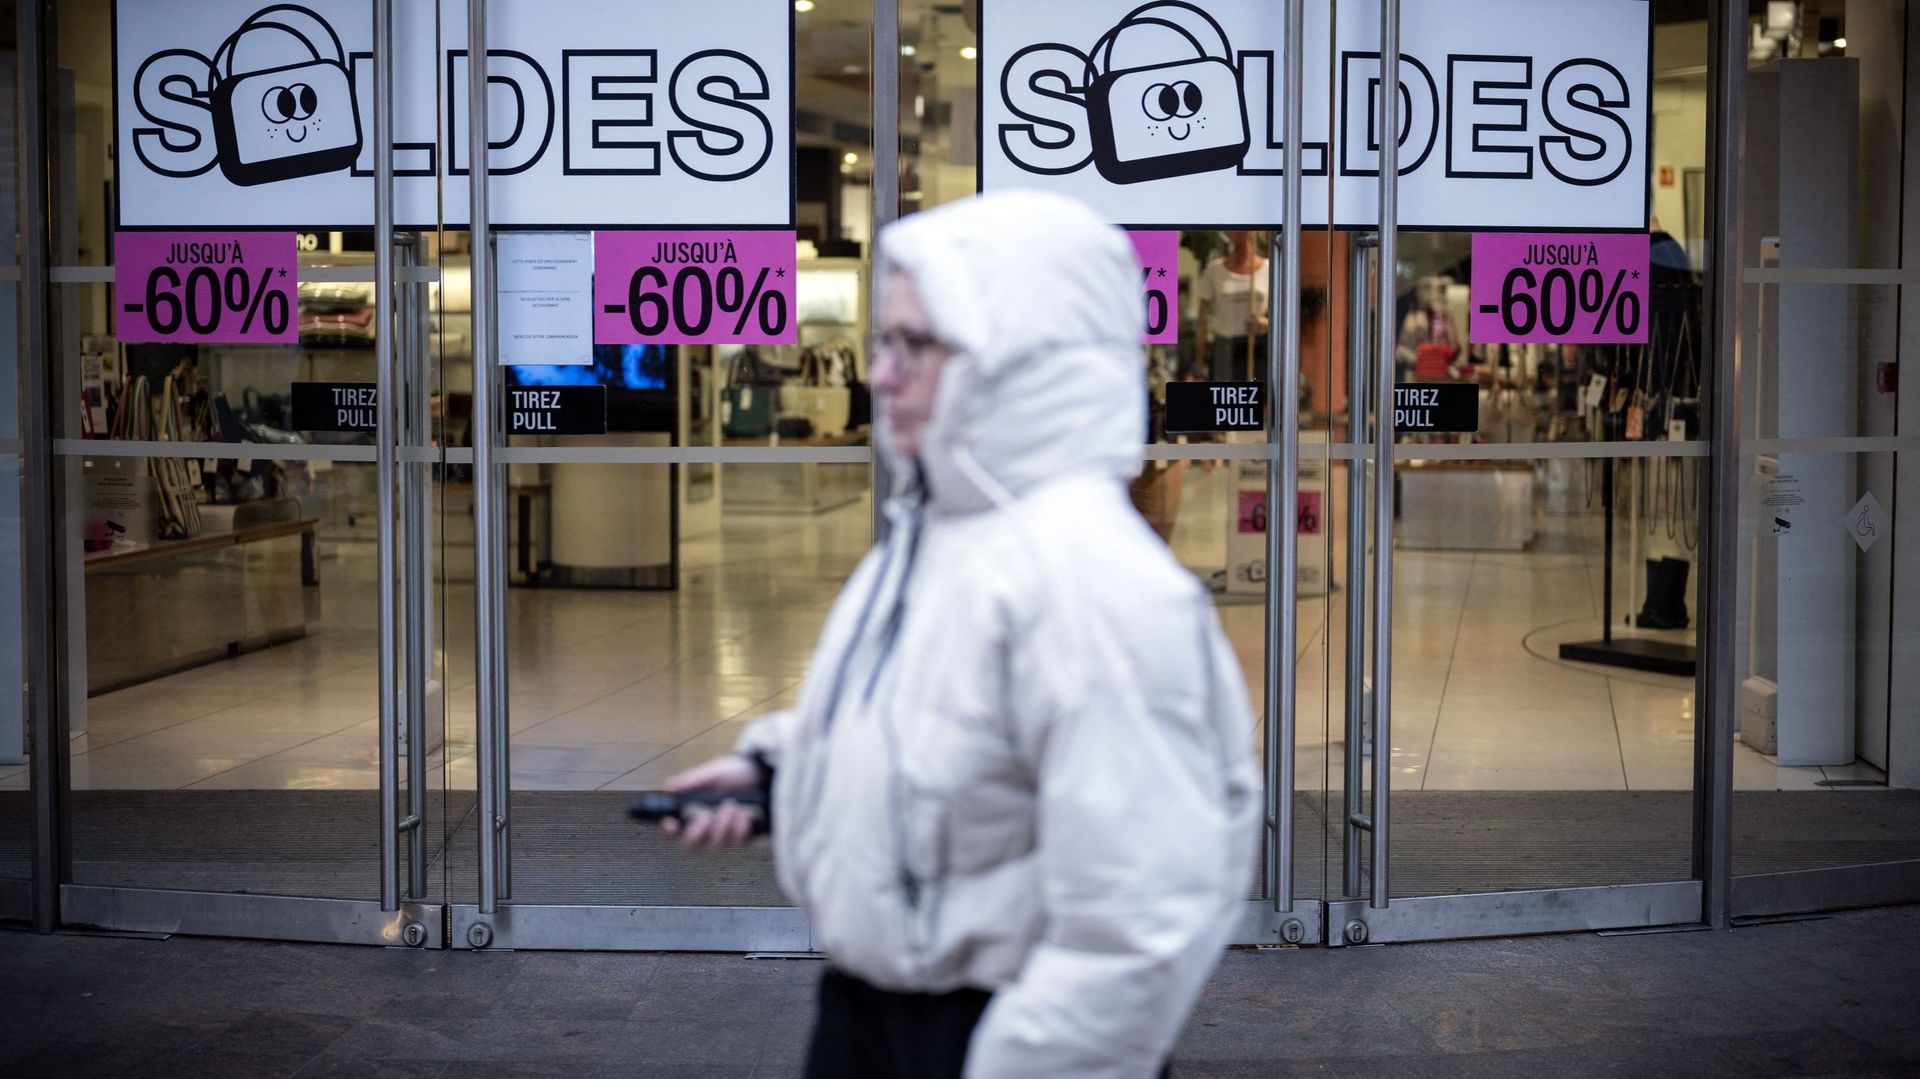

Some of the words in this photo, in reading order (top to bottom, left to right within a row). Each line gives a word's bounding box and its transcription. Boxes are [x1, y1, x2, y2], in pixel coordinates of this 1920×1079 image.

[133, 48, 774, 182] SLDES
[999, 42, 1633, 186] SLDES
[332, 388, 377, 406] TIREZ
[512, 391, 561, 409] TIREZ
[1210, 387, 1258, 405] TIREZ
[1395, 389, 1439, 406] TIREZ
[338, 409, 377, 427] PULL
[513, 412, 557, 430] PULL
[1216, 408, 1259, 426] PULL
[1395, 409, 1434, 427] PULL
